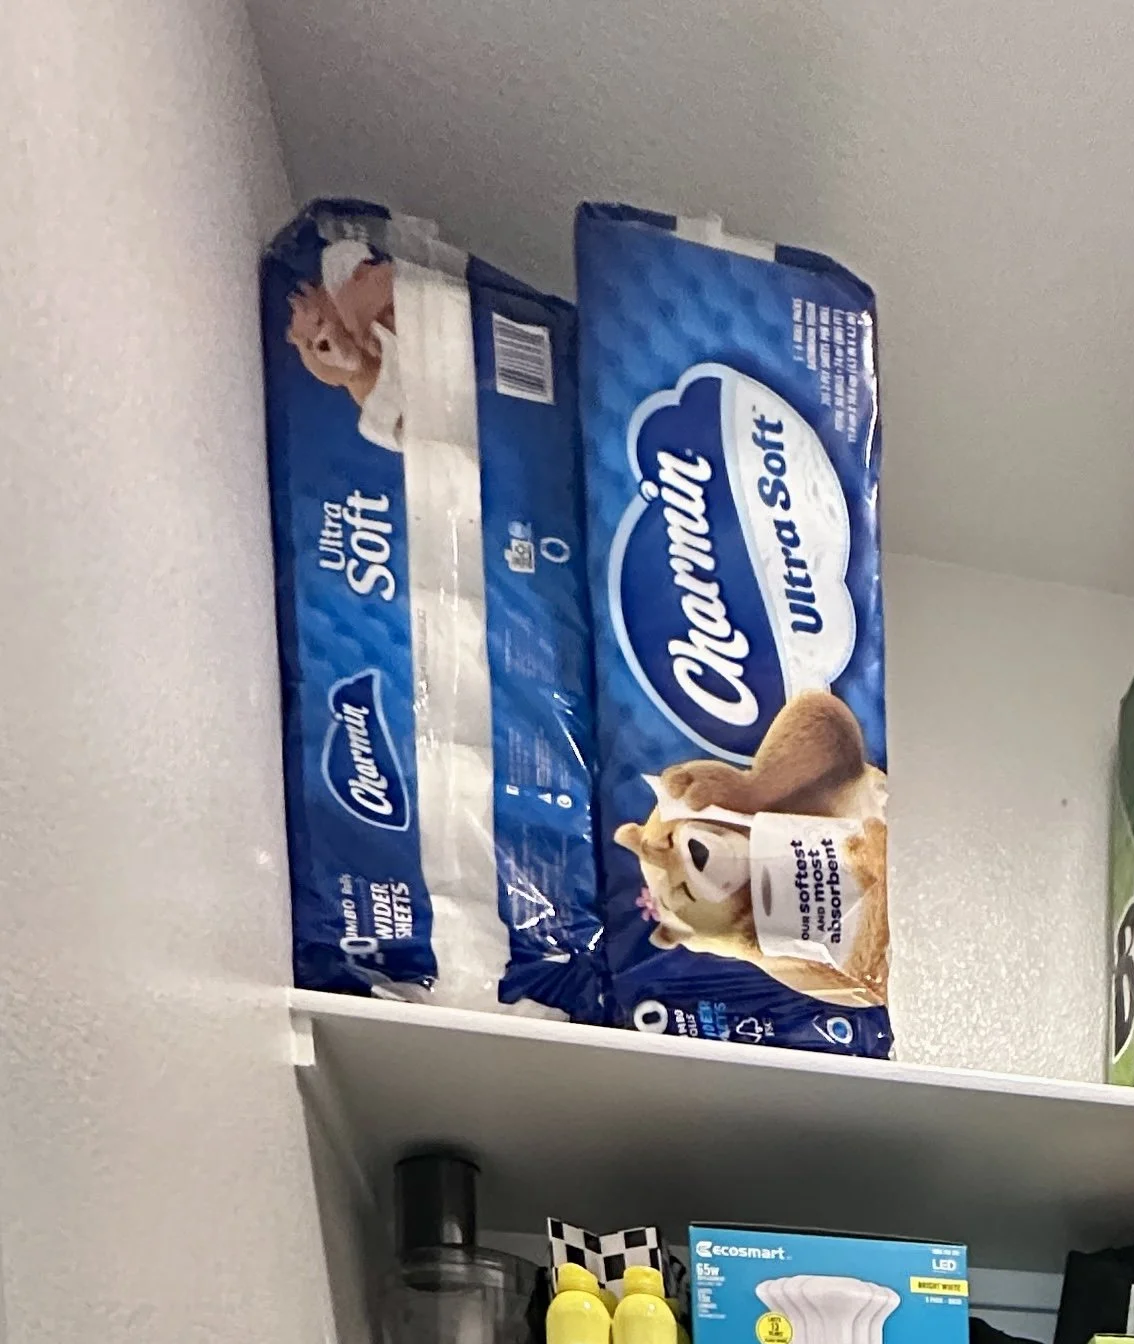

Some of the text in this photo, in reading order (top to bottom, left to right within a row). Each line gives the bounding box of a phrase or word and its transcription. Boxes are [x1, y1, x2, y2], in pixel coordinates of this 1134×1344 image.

[318, 502, 343, 571] Ultra
[344, 489, 397, 602] Soft
[750, 411, 824, 637] Ultra Soft
[656, 448, 761, 727] Charmin
[349, 701, 393, 817] Charmin
[369, 882, 394, 940] WIDER
[789, 839, 811, 914] softest
[807, 848, 825, 903] most
[820, 838, 842, 944] absorbent
[695, 1262, 720, 1276] 65w
[712, 1244, 786, 1261] ecosmart
[931, 1258, 957, 1272] LED
